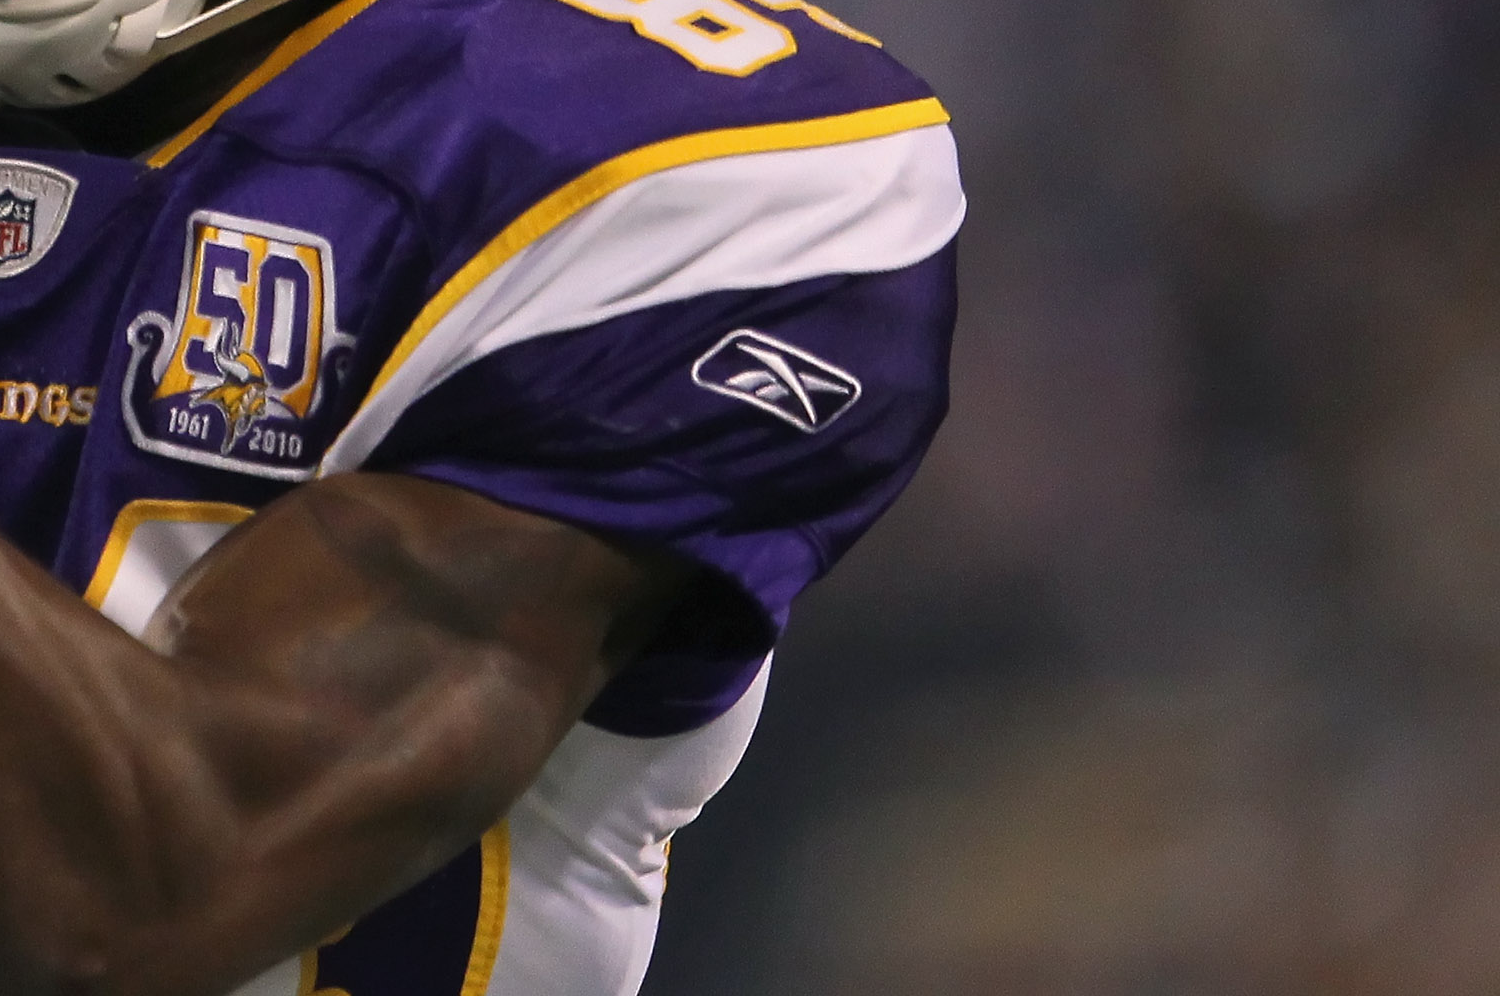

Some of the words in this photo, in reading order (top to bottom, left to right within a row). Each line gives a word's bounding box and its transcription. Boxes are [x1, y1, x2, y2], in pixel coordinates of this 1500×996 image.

[182, 240, 311, 391] 50
[168, 407, 210, 440] 1961
[248, 426, 303, 459] 2010
